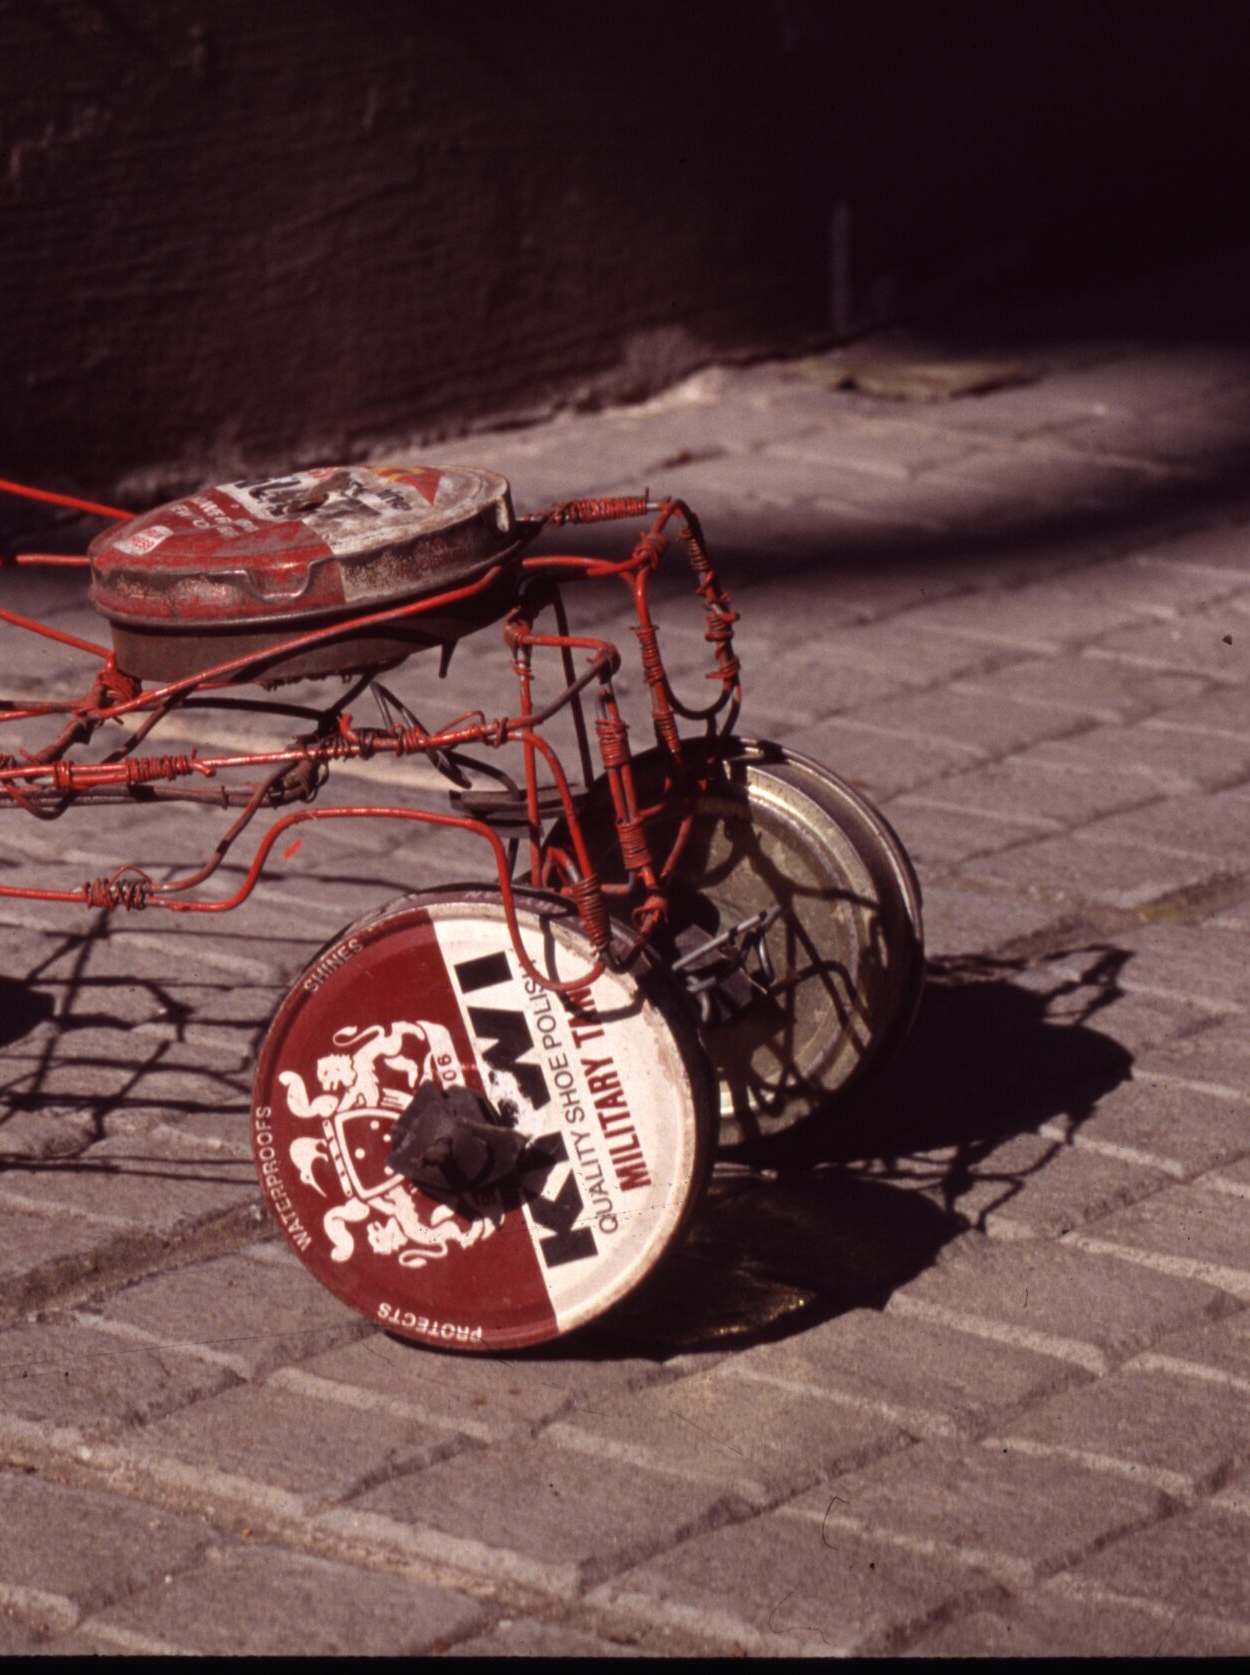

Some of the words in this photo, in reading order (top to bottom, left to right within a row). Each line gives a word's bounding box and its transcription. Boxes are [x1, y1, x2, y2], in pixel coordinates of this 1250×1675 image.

[303, 939, 364, 993] SHINES
[568, 987, 605, 1050] TAN
[454, 951, 599, 1268] KWI
[547, 1055, 587, 1125] SHOE
[586, 1055, 652, 1191] MILITARY
[255, 1105, 311, 1251] WATERPROOFS
[565, 1130, 620, 1235] QUALITY
[376, 1302, 483, 1343] PROTECTS
